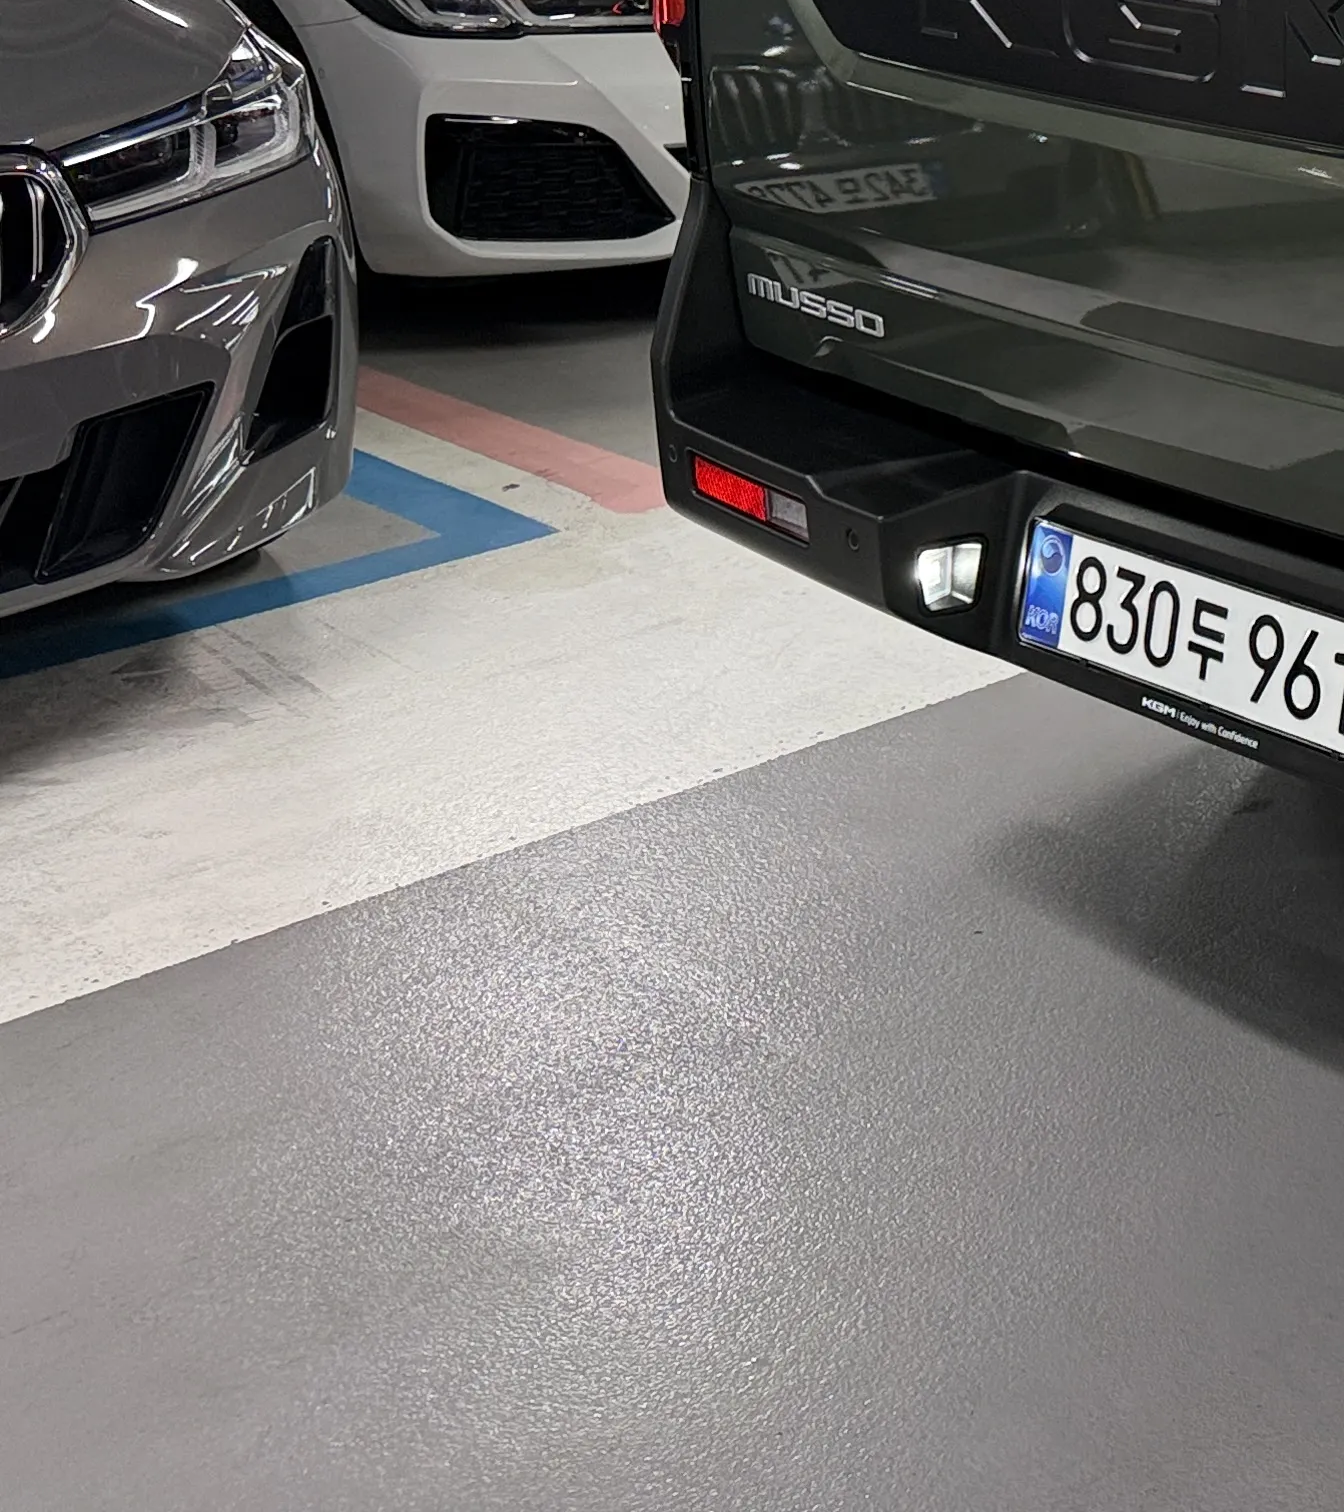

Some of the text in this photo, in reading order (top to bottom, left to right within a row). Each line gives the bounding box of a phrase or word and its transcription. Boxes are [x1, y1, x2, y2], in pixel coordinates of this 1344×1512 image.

[747, 273, 885, 338] MUSSO
[1025, 604, 1059, 635] KOR
[1069, 555, 1229, 680] 830두
[1141, 696, 1259, 750] KGM Enjoy with Confidence
